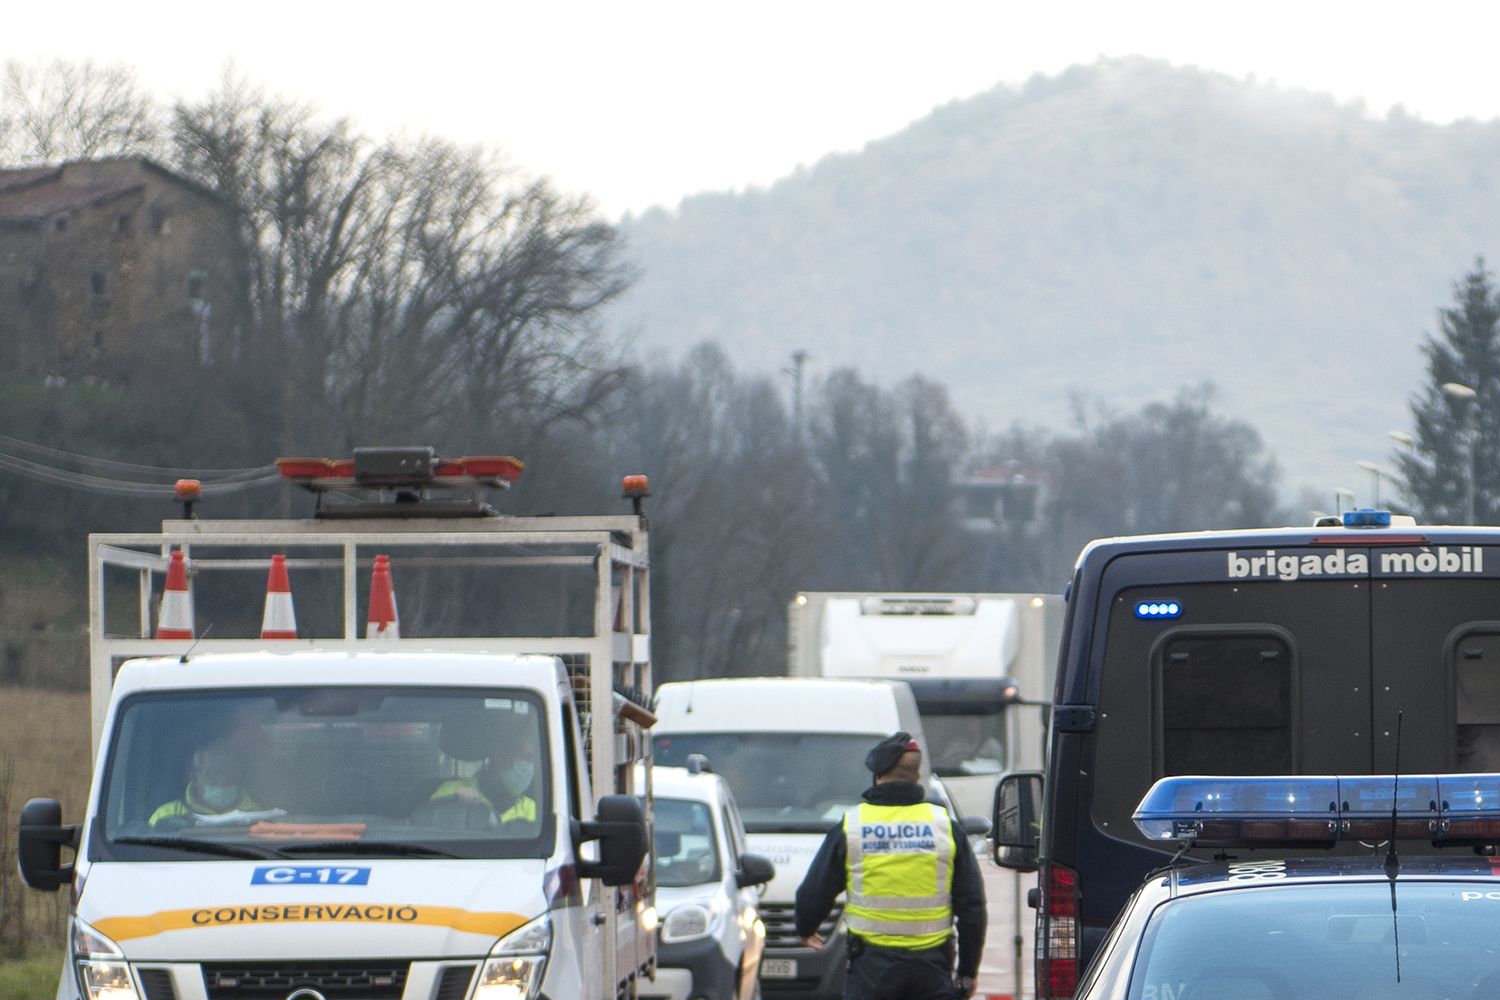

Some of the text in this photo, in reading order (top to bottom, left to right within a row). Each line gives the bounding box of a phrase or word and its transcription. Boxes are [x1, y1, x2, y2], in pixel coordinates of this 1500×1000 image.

[1227, 546, 1483, 581] brigada mòbil
[862, 825, 934, 838] POLICIA
[264, 867, 359, 884] C-17
[191, 904, 418, 925] CONSERVACIÓ
